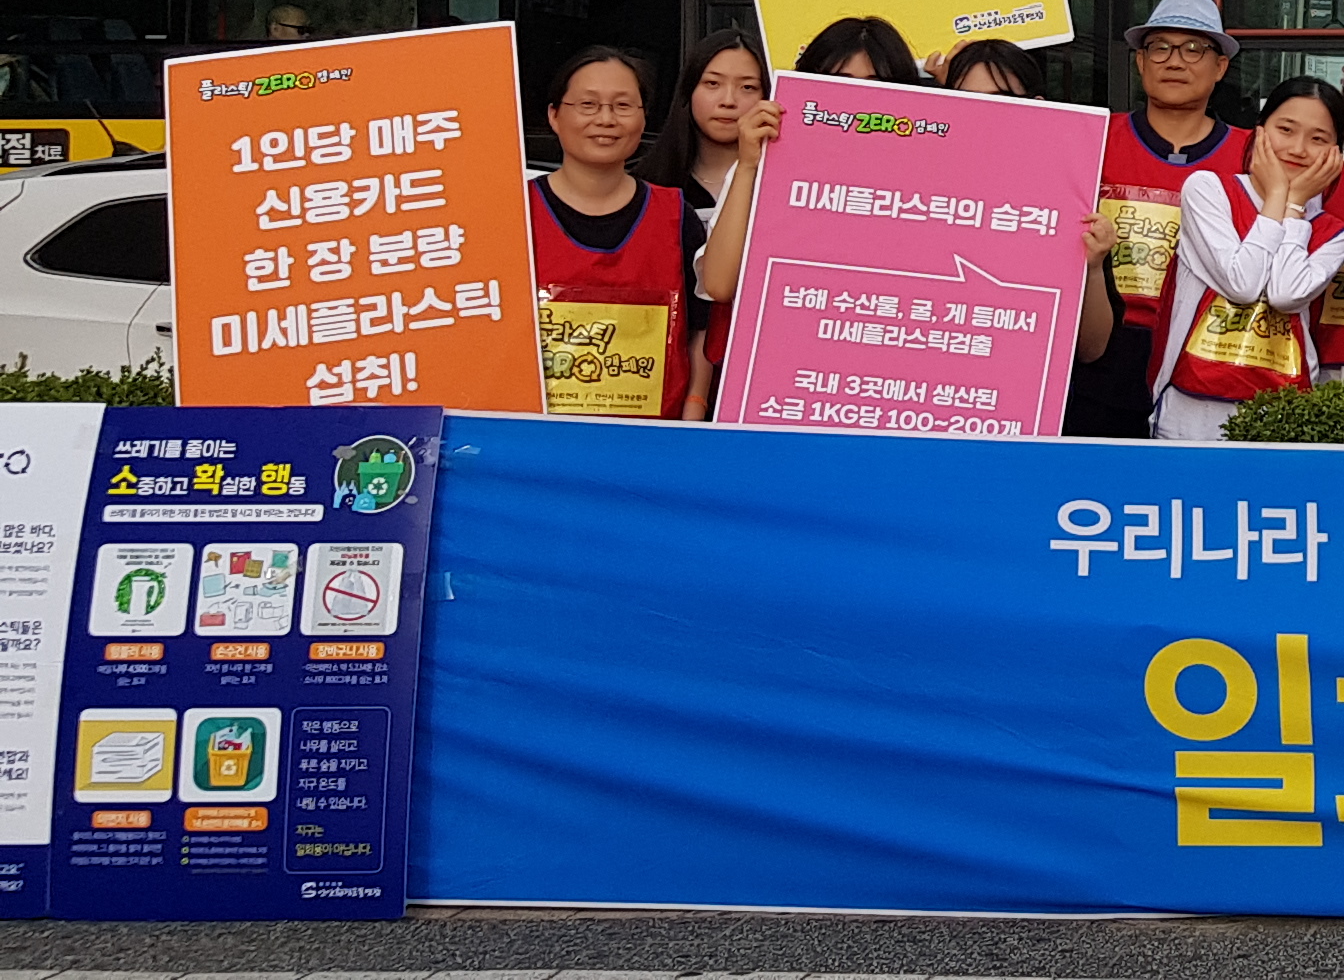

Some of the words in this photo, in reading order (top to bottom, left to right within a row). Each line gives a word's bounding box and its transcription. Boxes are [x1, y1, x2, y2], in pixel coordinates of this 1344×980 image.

[199, 79, 253, 101] 플라스틱
[255, 72, 315, 97] ZERO
[802, 100, 855, 132] 플라스틱
[854, 111, 914, 137] ZERO
[33, 145, 65, 162] 치료
[230, 121, 357, 174] 1인당
[368, 109, 462, 157] 매주
[254, 168, 447, 231] 신용카드
[789, 179, 985, 229] 미세플라스틱의
[989, 202, 1061, 236] 습격!
[244, 246, 295, 292] 한
[306, 238, 357, 283] 장
[368, 224, 465, 276] 분량
[210, 279, 501, 357] 미세플라스틱
[782, 285, 828, 311] 남해
[832, 289, 904, 320] 수산물,
[908, 299, 938, 326] 굴,
[946, 301, 967, 327] 게
[971, 306, 1038, 334] 등에서
[817, 317, 994, 358] 미세플라스틱검출
[306, 351, 419, 406] 섭취!
[603, 353, 655, 379] 캠페인
[758, 394, 806, 422] 소금
[810, 400, 883, 428] 1KG당
[793, 369, 838, 396] 국내
[843, 373, 927, 404] 3곳에서
[931, 382, 998, 412] 생산된
[113, 439, 183, 459] 쓰레기를
[185, 439, 237, 459] 줄이는
[106, 464, 189, 496] 소중하고
[192, 463, 257, 496] 확실한
[260, 463, 307, 496] 행동
[1048, 498, 1328, 582] 우리나라
